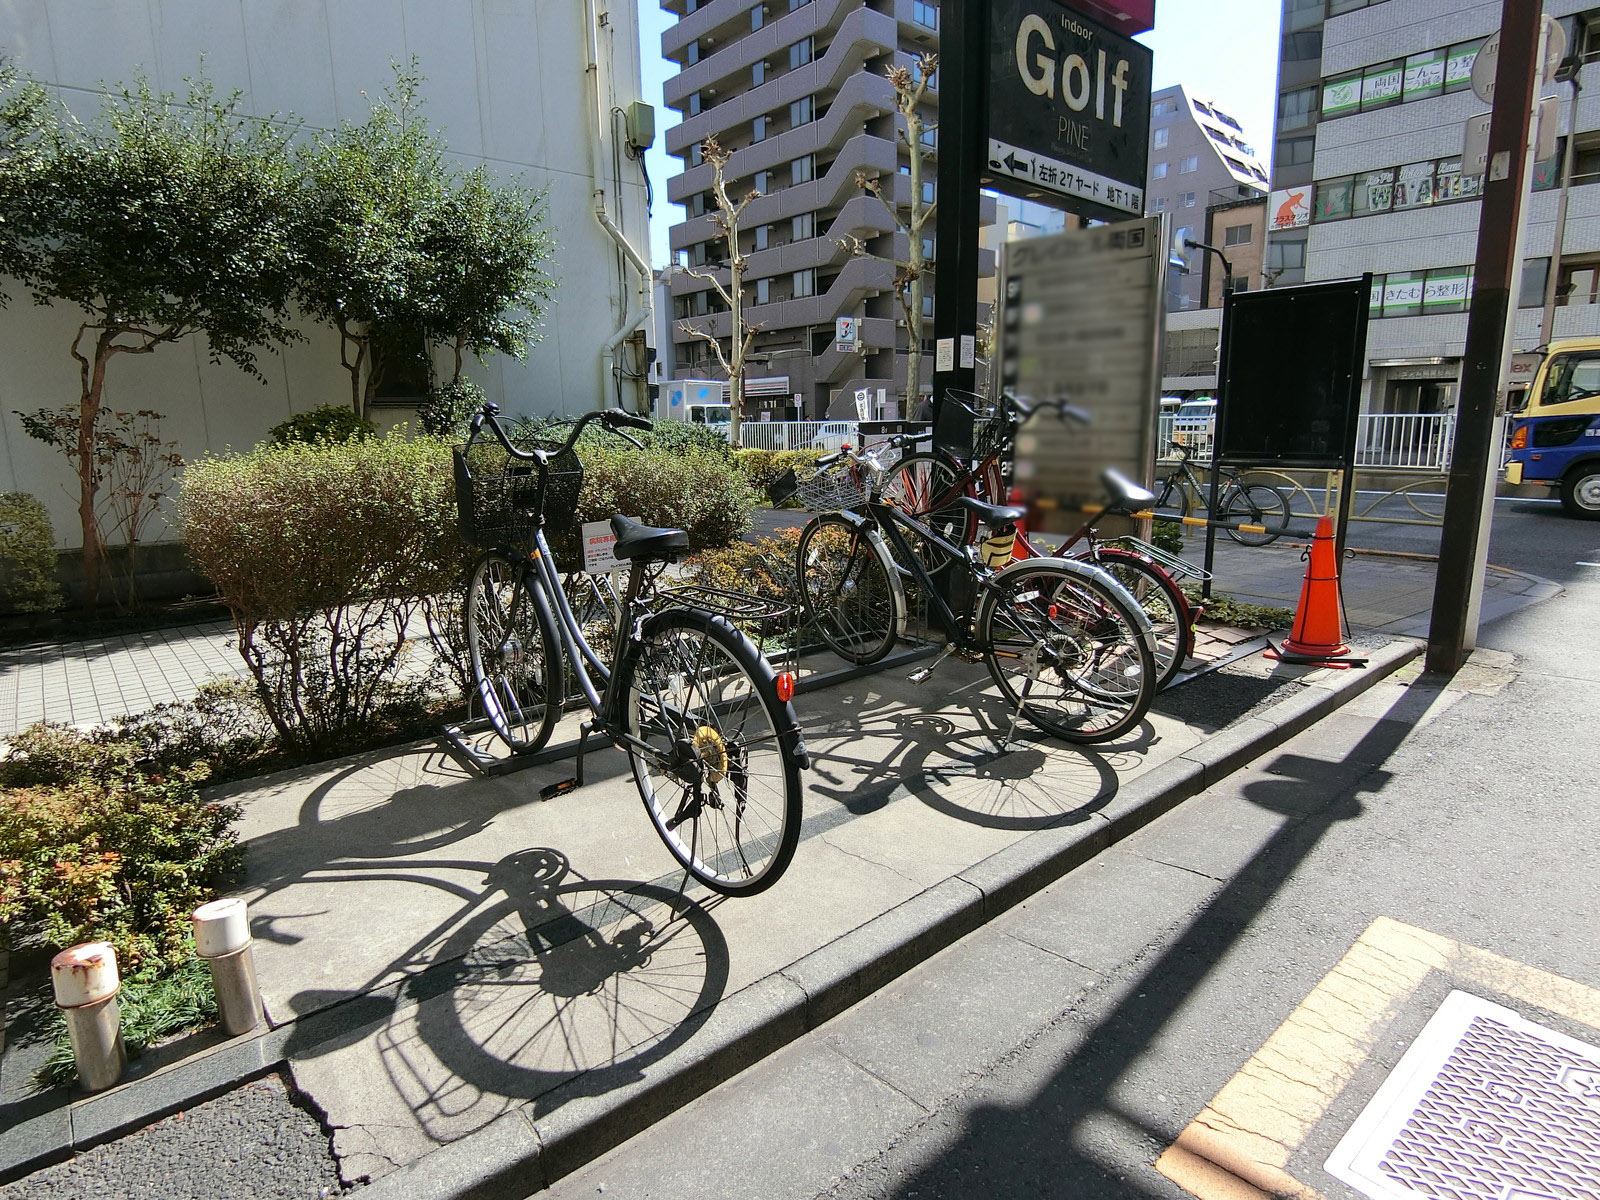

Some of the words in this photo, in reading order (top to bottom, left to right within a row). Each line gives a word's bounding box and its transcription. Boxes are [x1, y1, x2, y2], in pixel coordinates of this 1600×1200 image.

[1061, 14, 1093, 41] Indoor
[1015, 14, 1129, 128] Golf
[1058, 116, 1089, 151] PINE
